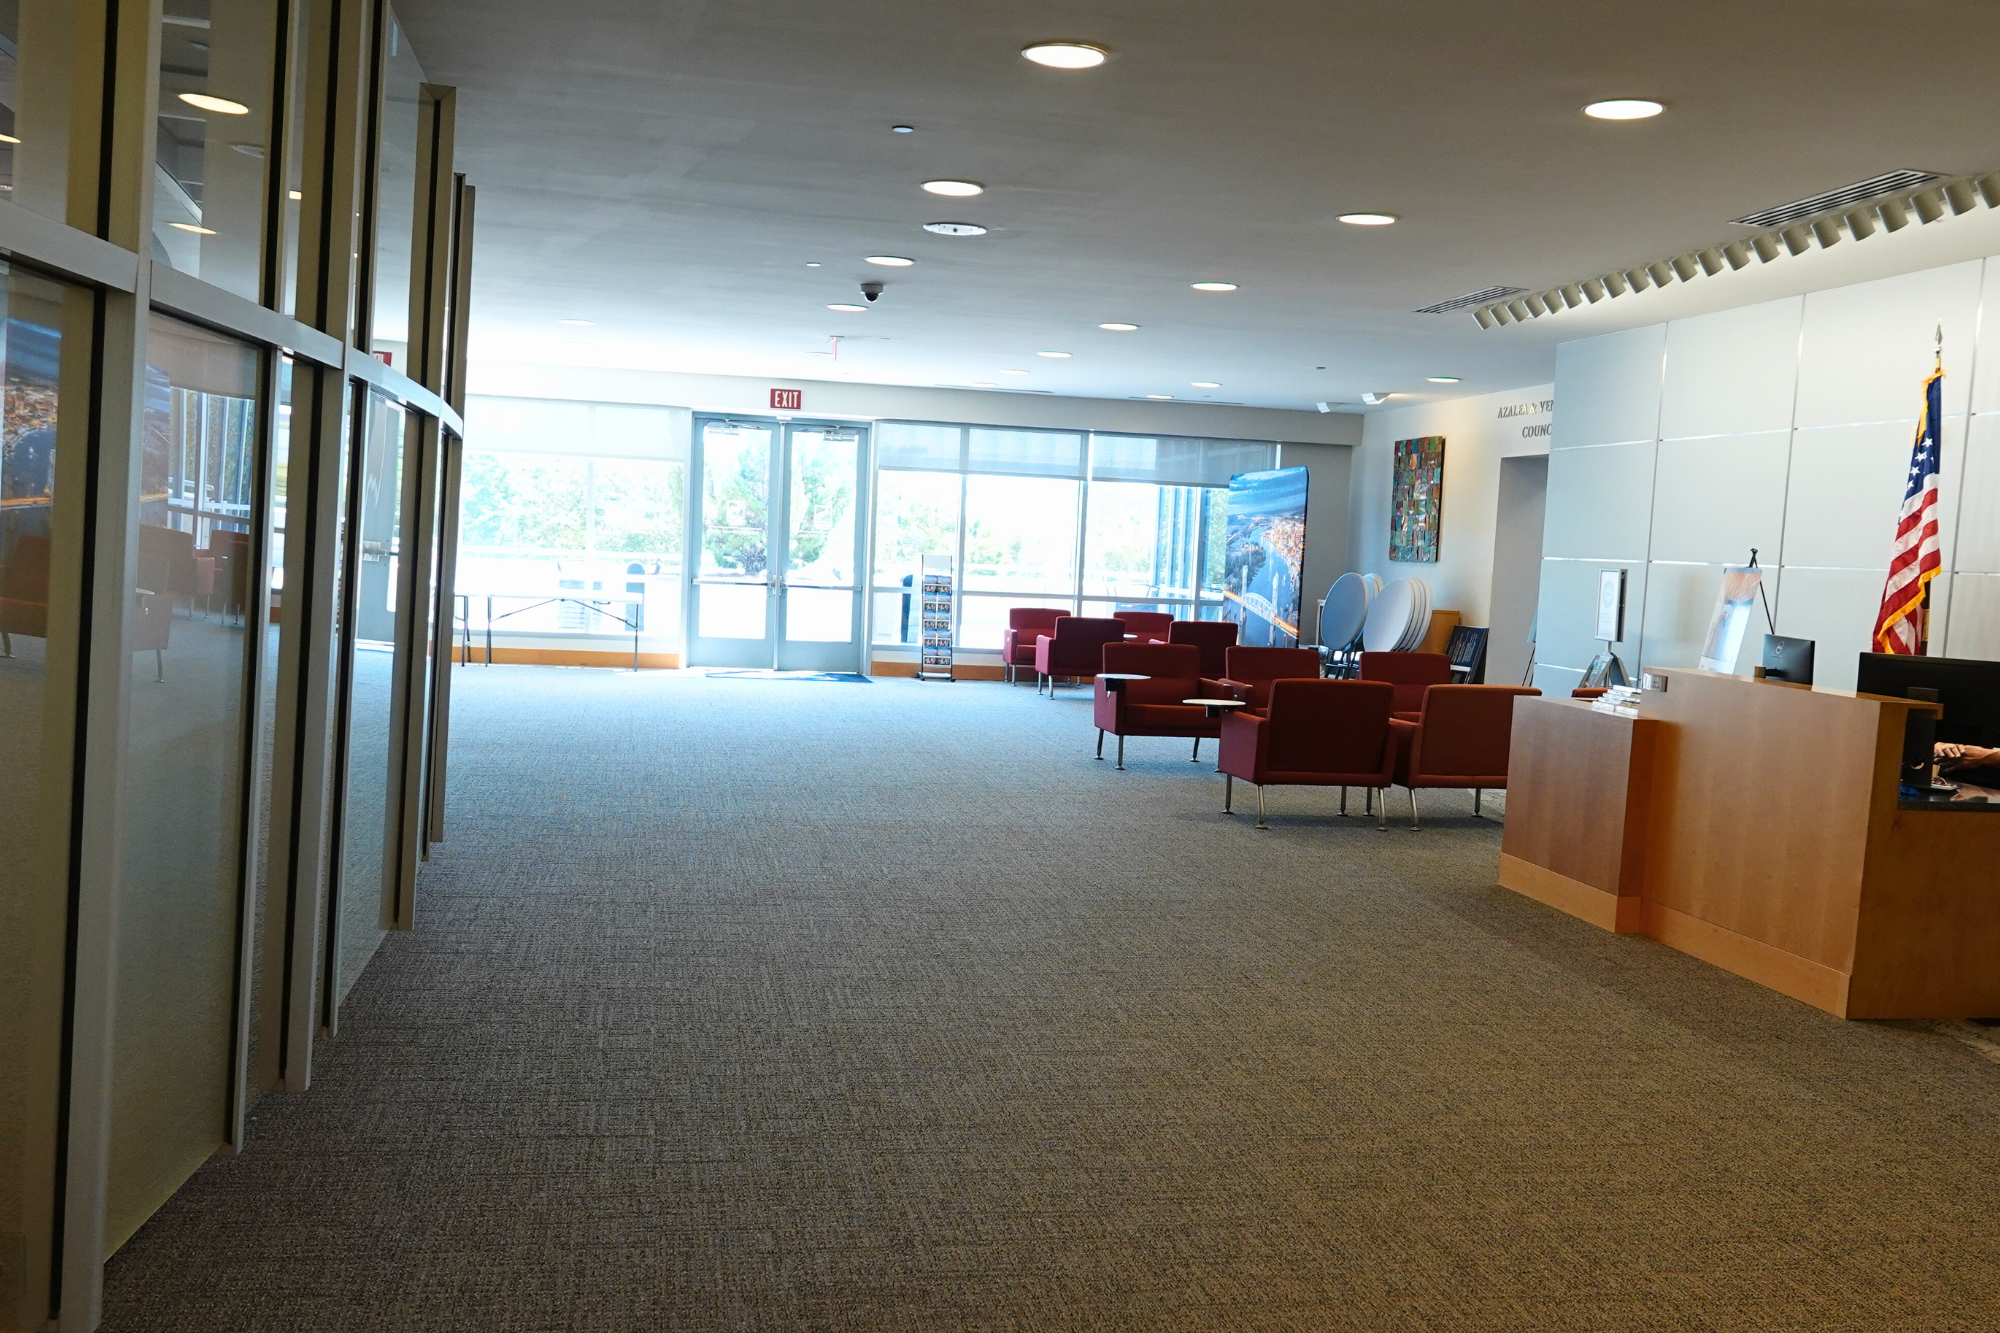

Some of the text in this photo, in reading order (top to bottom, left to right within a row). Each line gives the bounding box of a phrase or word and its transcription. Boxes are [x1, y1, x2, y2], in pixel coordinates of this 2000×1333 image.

[774, 390, 799, 408] EXIT
[1497, 403, 1529, 418] AZALEA
[1530, 402, 1537, 414] &
